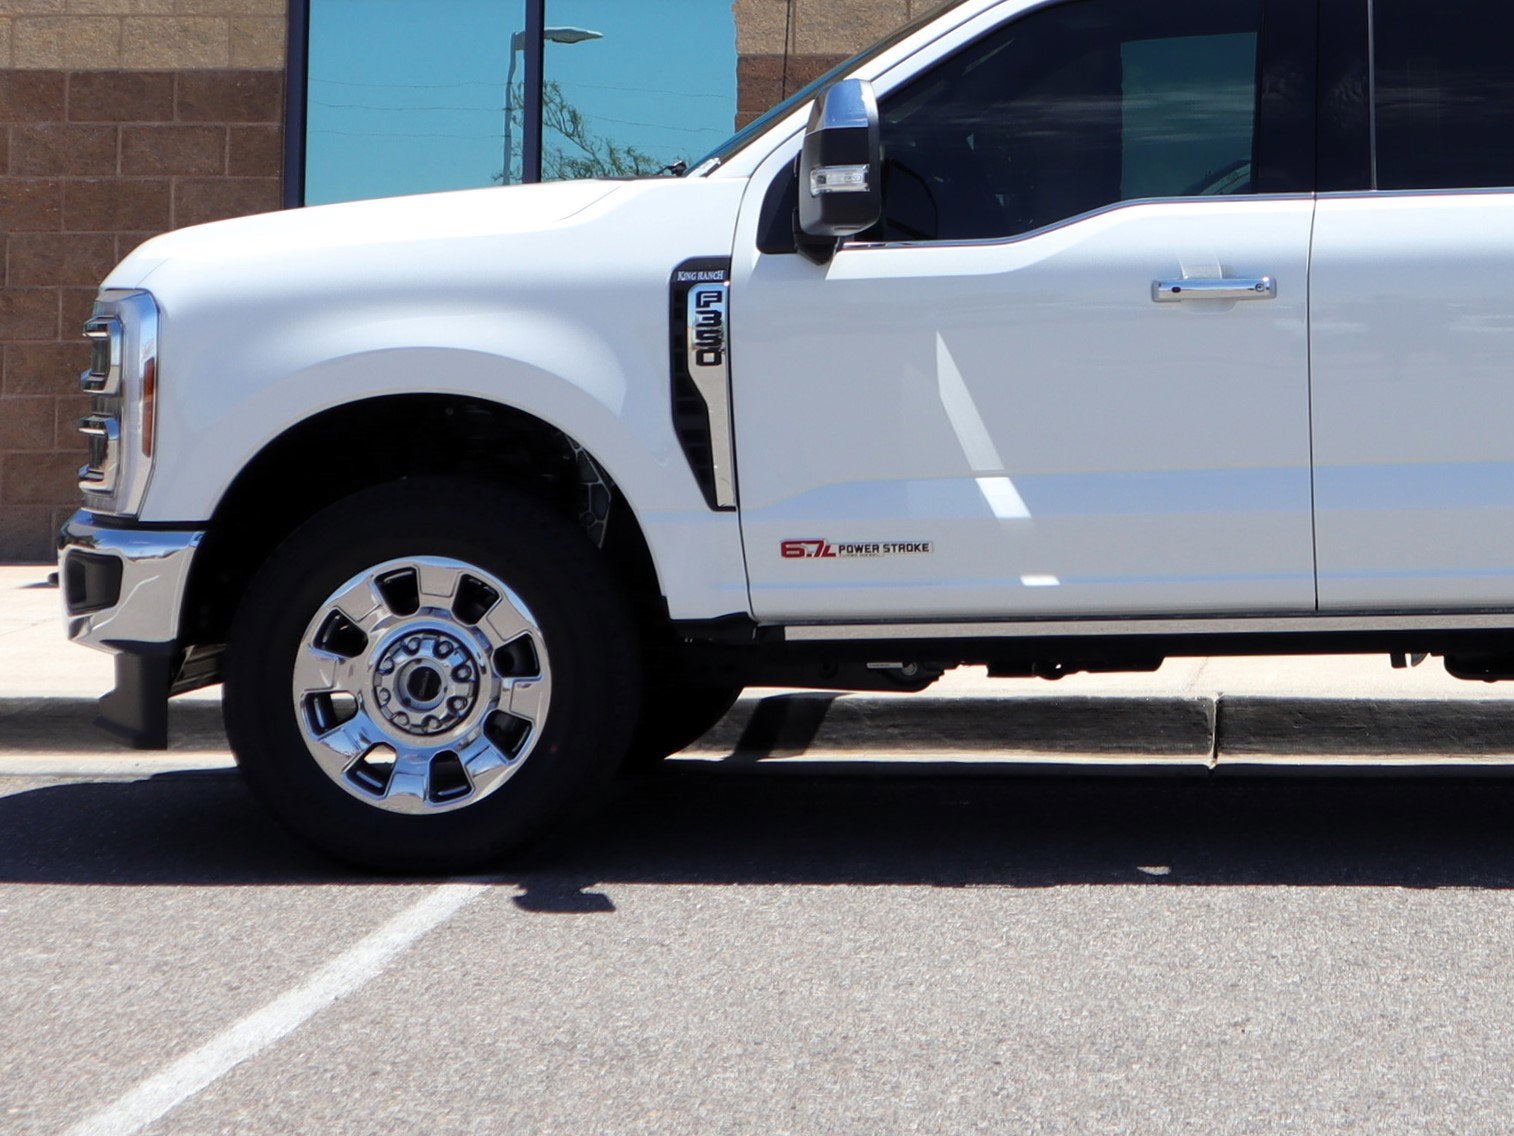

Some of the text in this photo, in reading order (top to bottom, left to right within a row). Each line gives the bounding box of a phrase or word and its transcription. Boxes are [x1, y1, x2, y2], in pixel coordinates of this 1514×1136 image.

[677, 270, 725, 281] KING RANCH
[780, 539, 836, 559] 6.7L
[838, 543, 880, 554] POWER
[883, 542, 930, 553] STROKE
